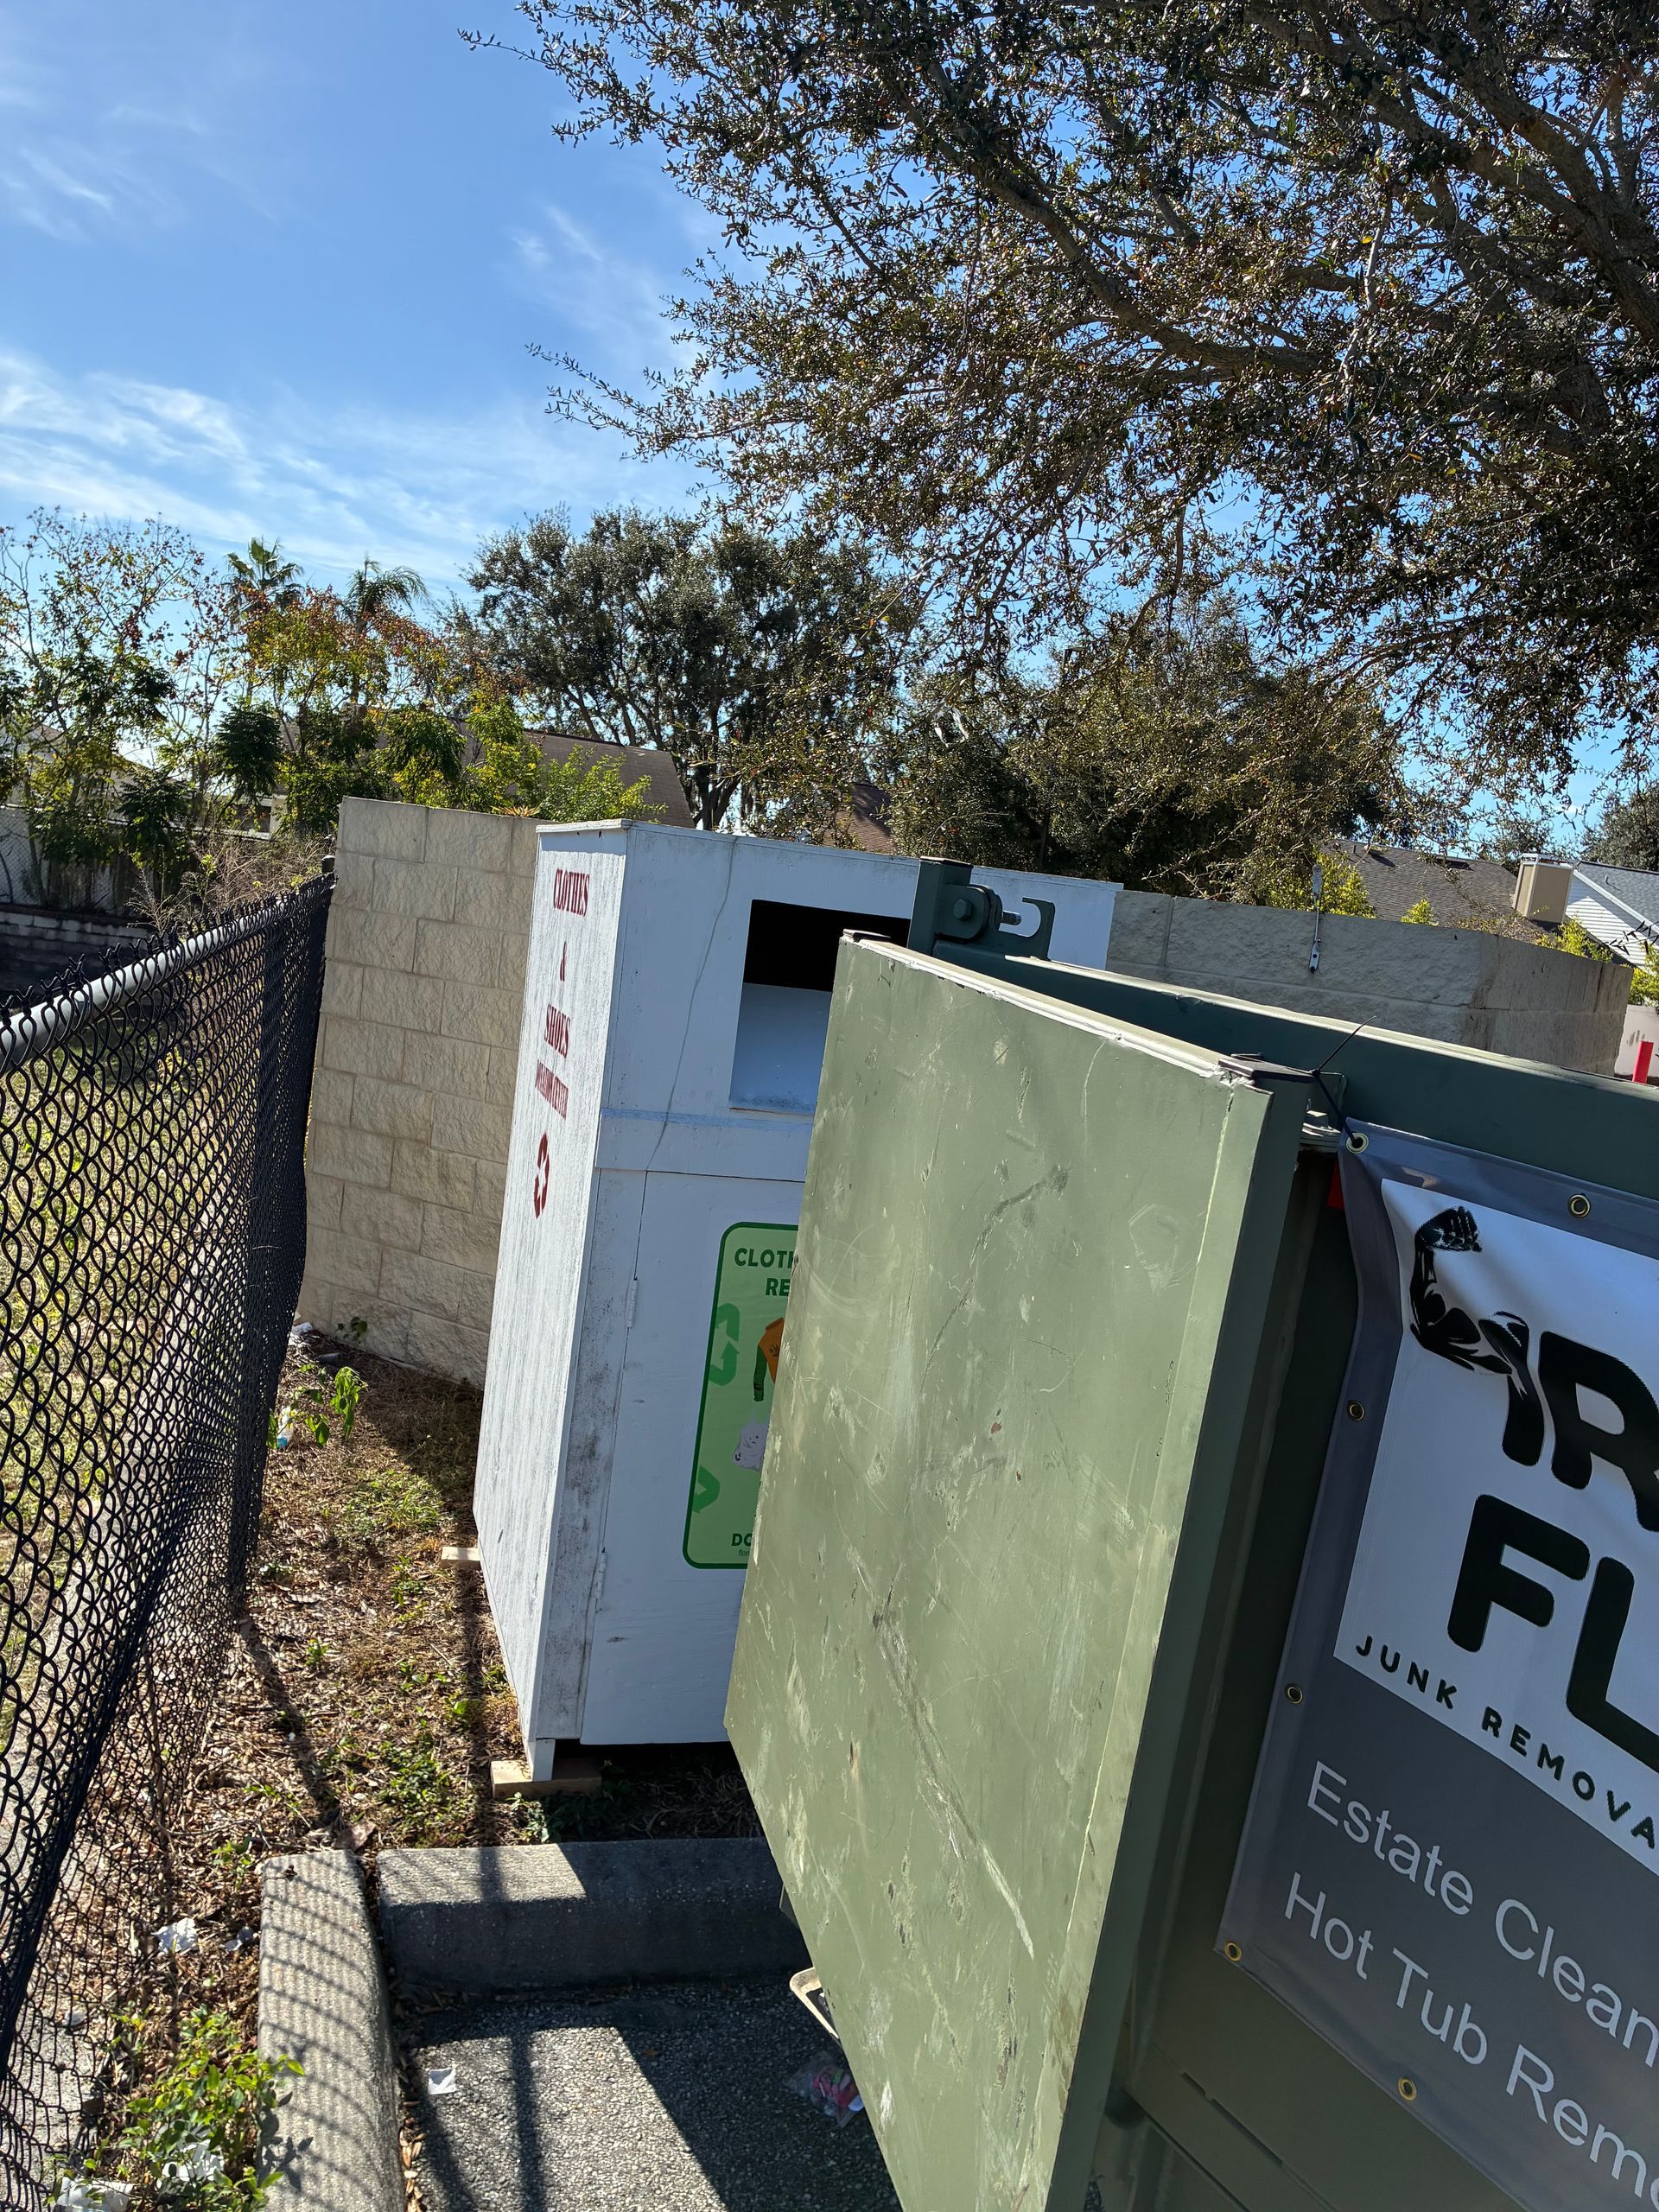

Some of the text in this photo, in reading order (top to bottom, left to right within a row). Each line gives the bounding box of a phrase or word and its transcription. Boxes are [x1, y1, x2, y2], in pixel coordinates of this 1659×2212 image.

[554, 868, 590, 917] CLOTHES
[544, 1003, 571, 1058] SHOES
[1356, 1636, 1656, 1849] JUNK REMOVA
[1307, 1761, 1659, 2068] Estate Clean
[1285, 1872, 1659, 2212] Hot Tub Rem
